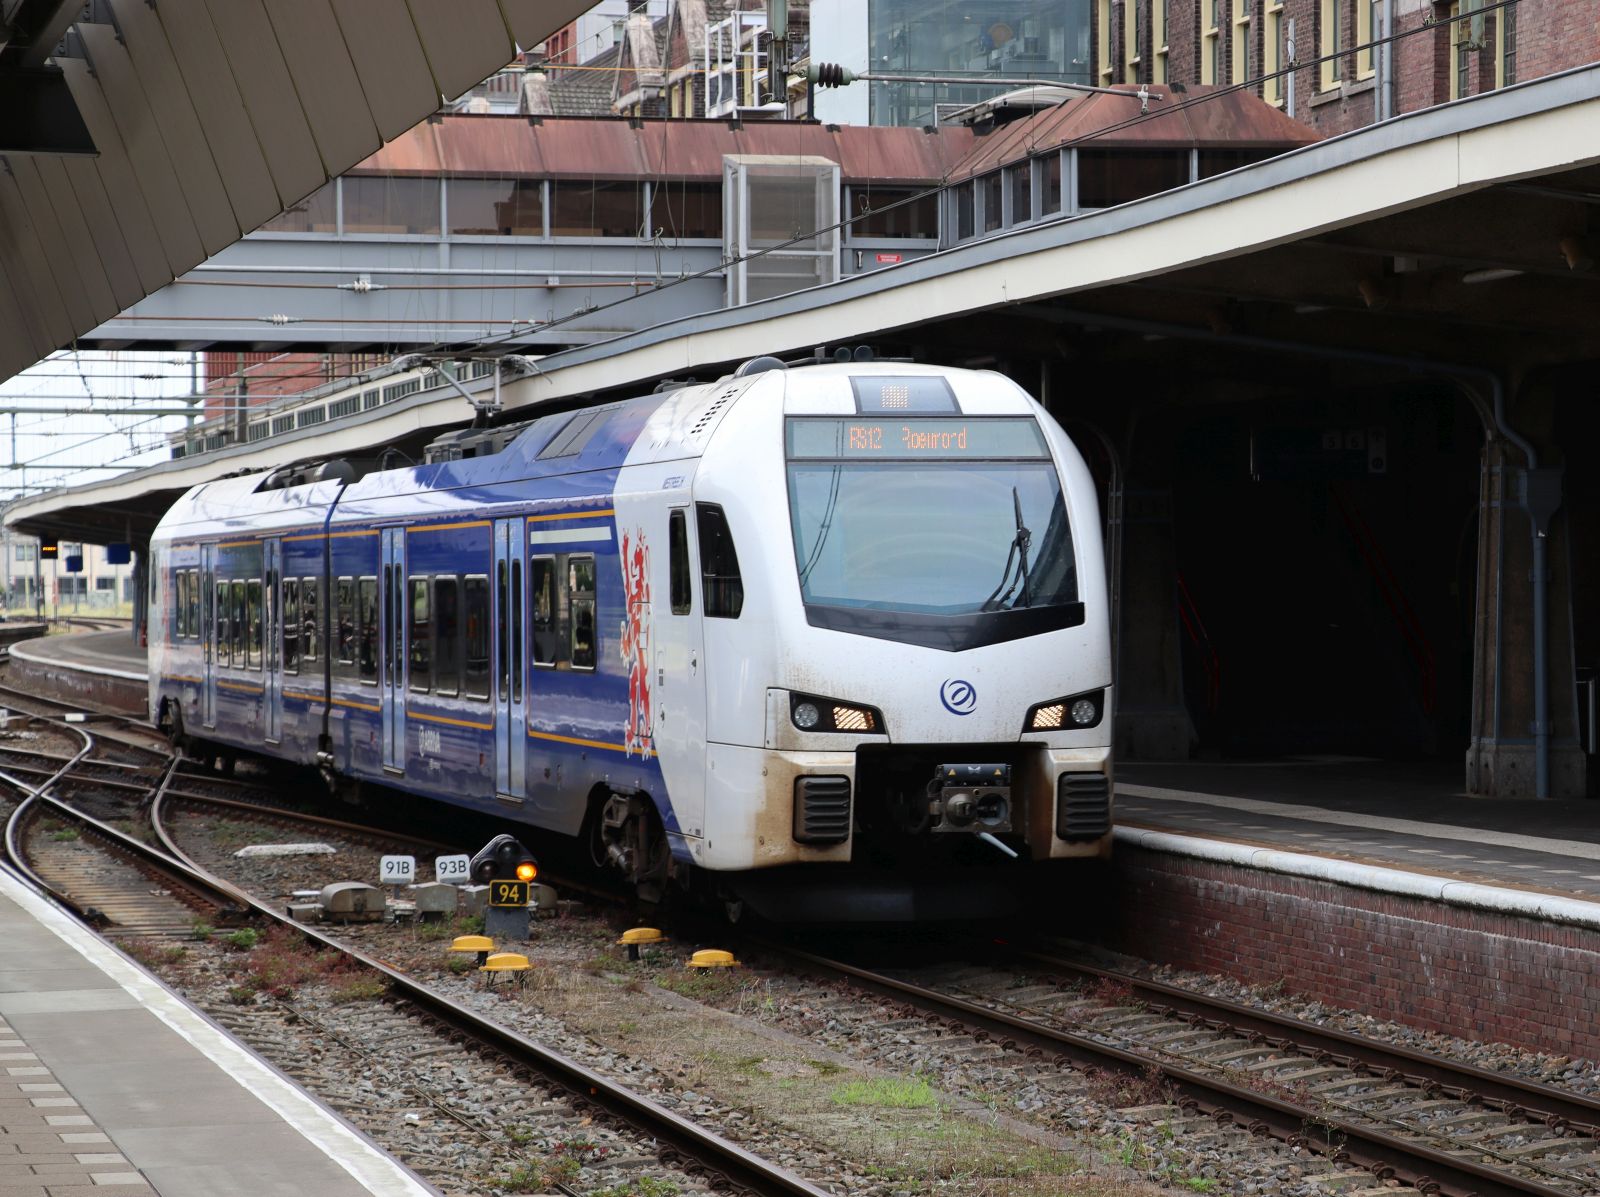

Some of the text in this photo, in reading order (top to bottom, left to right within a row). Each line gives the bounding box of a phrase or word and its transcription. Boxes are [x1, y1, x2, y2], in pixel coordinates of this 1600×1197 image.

[424, 729, 441, 753] ARRIVA
[385, 860, 410, 875] 91B
[439, 860, 467, 875] 93B
[499, 884, 520, 902] 94
